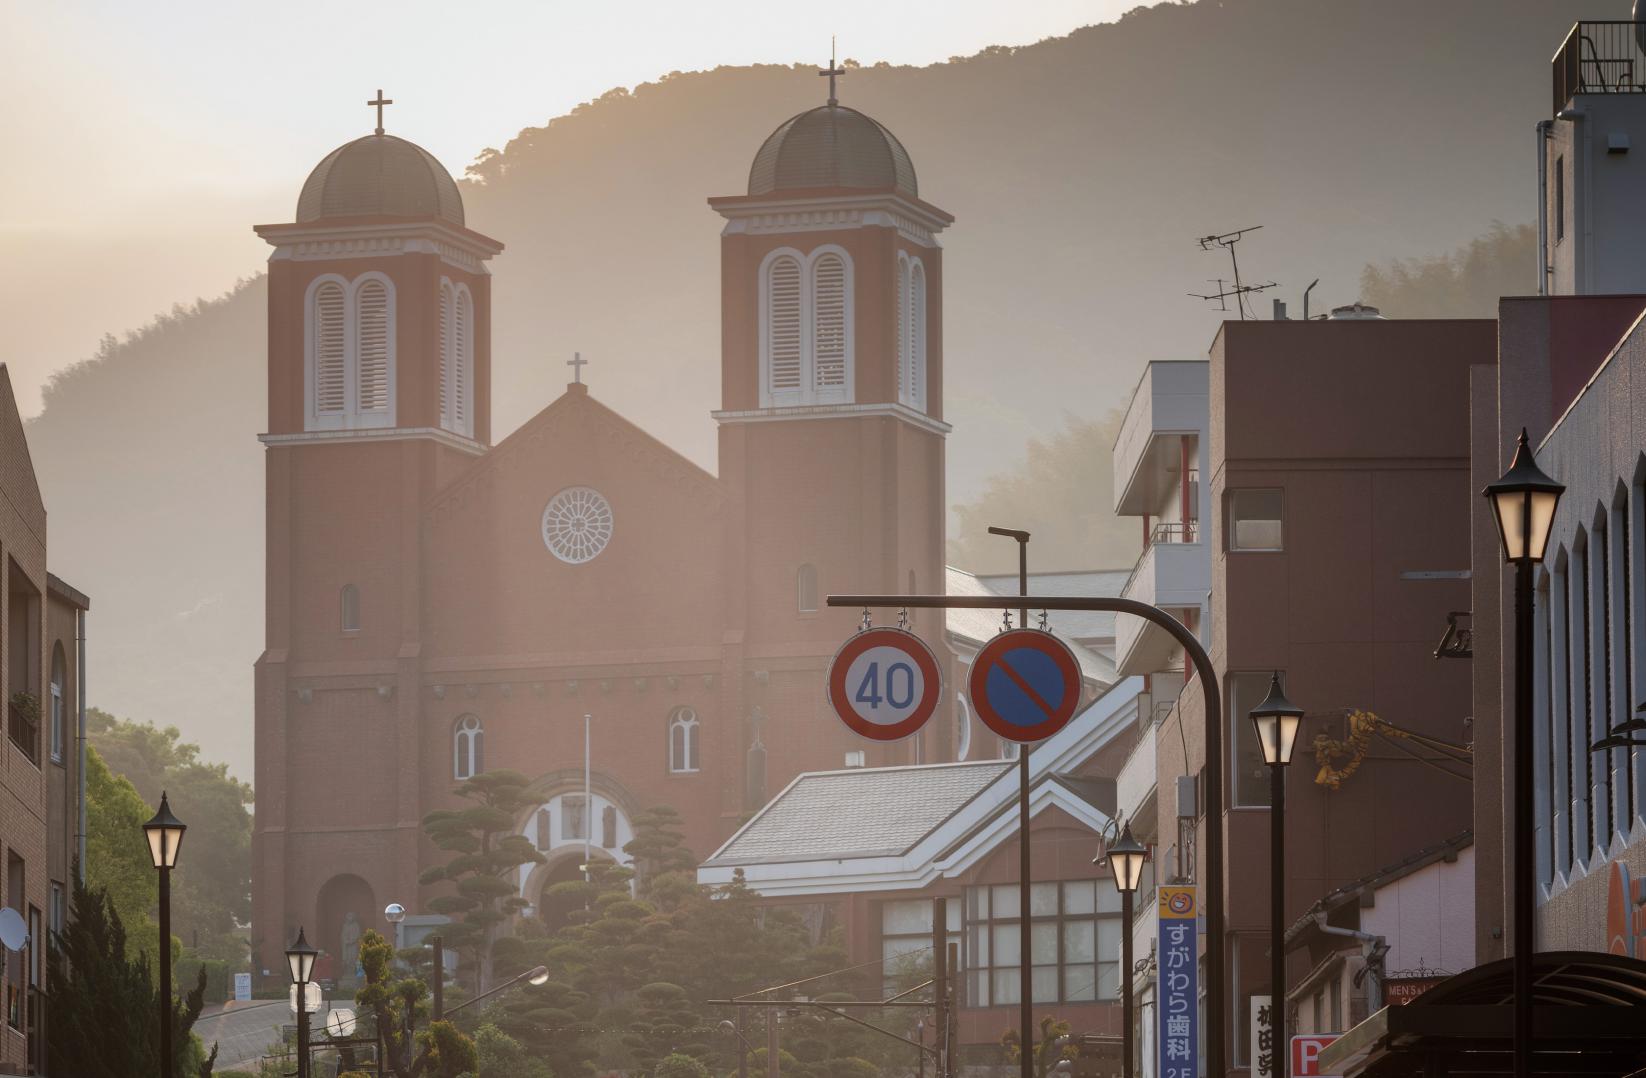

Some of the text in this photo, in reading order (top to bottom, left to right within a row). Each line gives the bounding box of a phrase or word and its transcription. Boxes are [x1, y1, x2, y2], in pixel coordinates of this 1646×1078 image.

[855, 662, 914, 709] 40
[1167, 924, 1190, 1060] すがわら歯科
[1301, 1040, 1323, 1074] P
